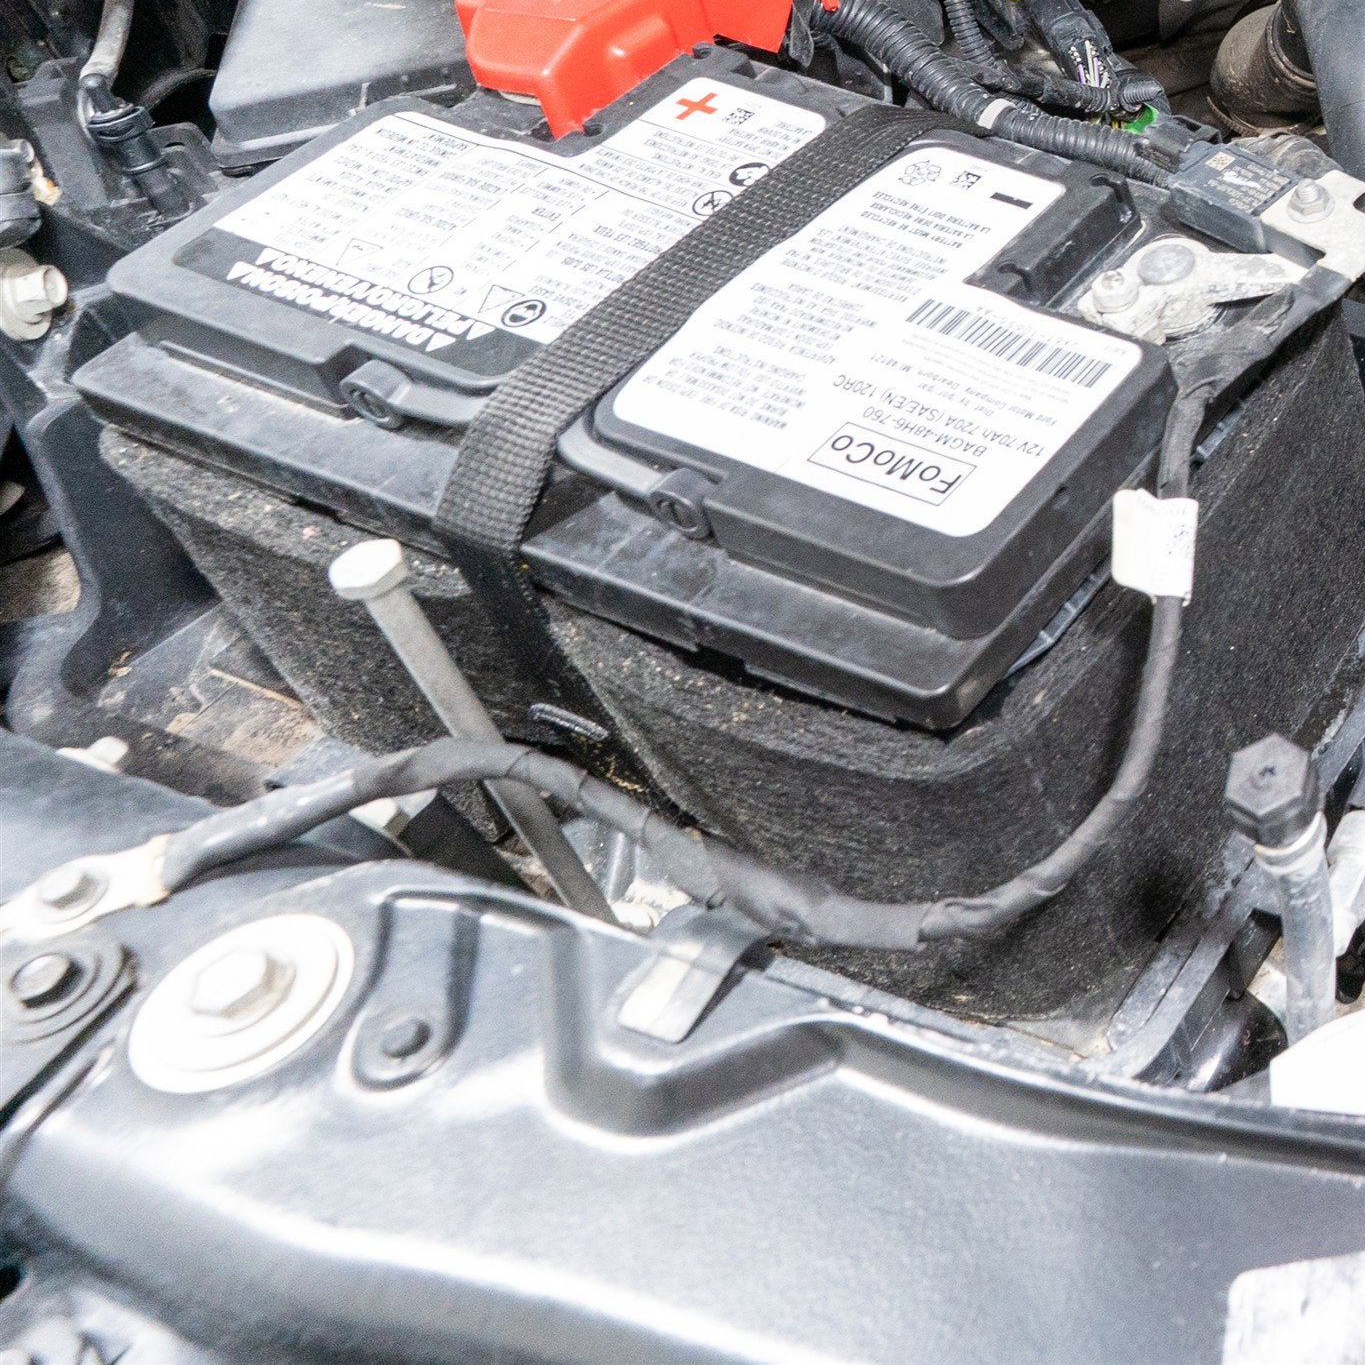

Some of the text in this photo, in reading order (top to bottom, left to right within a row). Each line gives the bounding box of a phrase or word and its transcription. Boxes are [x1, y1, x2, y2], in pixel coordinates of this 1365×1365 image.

[236, 266, 438, 346] DANGER/POISON
[271, 252, 478, 335] PELIGRO/VENENO
[832, 373, 1044, 457] 12V 70Ah 720A (SAE/EN) 120RC
[862, 406, 988, 458] BAGM-48H6-760
[830, 434, 962, 495] FoMoCo
